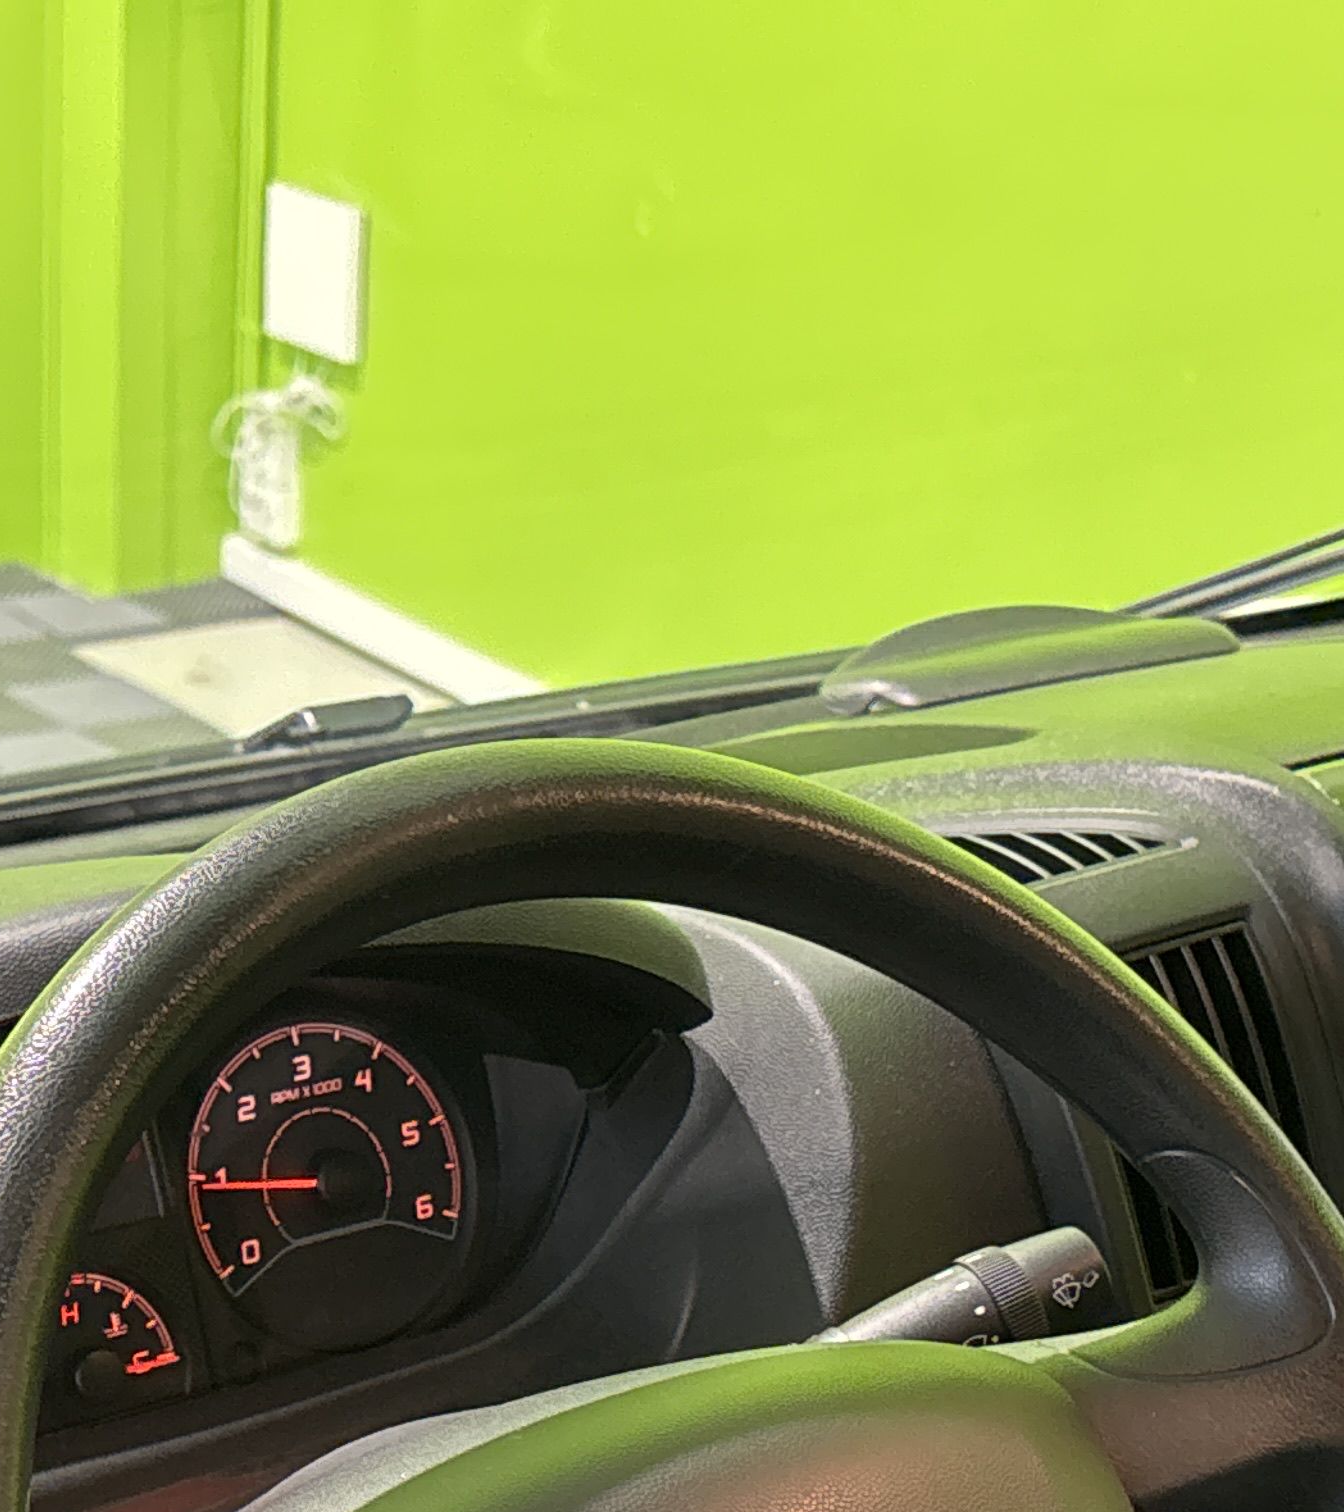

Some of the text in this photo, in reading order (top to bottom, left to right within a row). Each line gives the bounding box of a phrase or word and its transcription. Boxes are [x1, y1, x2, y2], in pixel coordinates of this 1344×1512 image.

[291, 1054, 312, 1082] 3
[354, 1068, 373, 1093] 4
[237, 1094, 256, 1123] 2
[400, 1119, 421, 1147] 5
[415, 1193, 435, 1220] 6
[240, 1238, 261, 1265] 0
[60, 1300, 79, 1326] H
